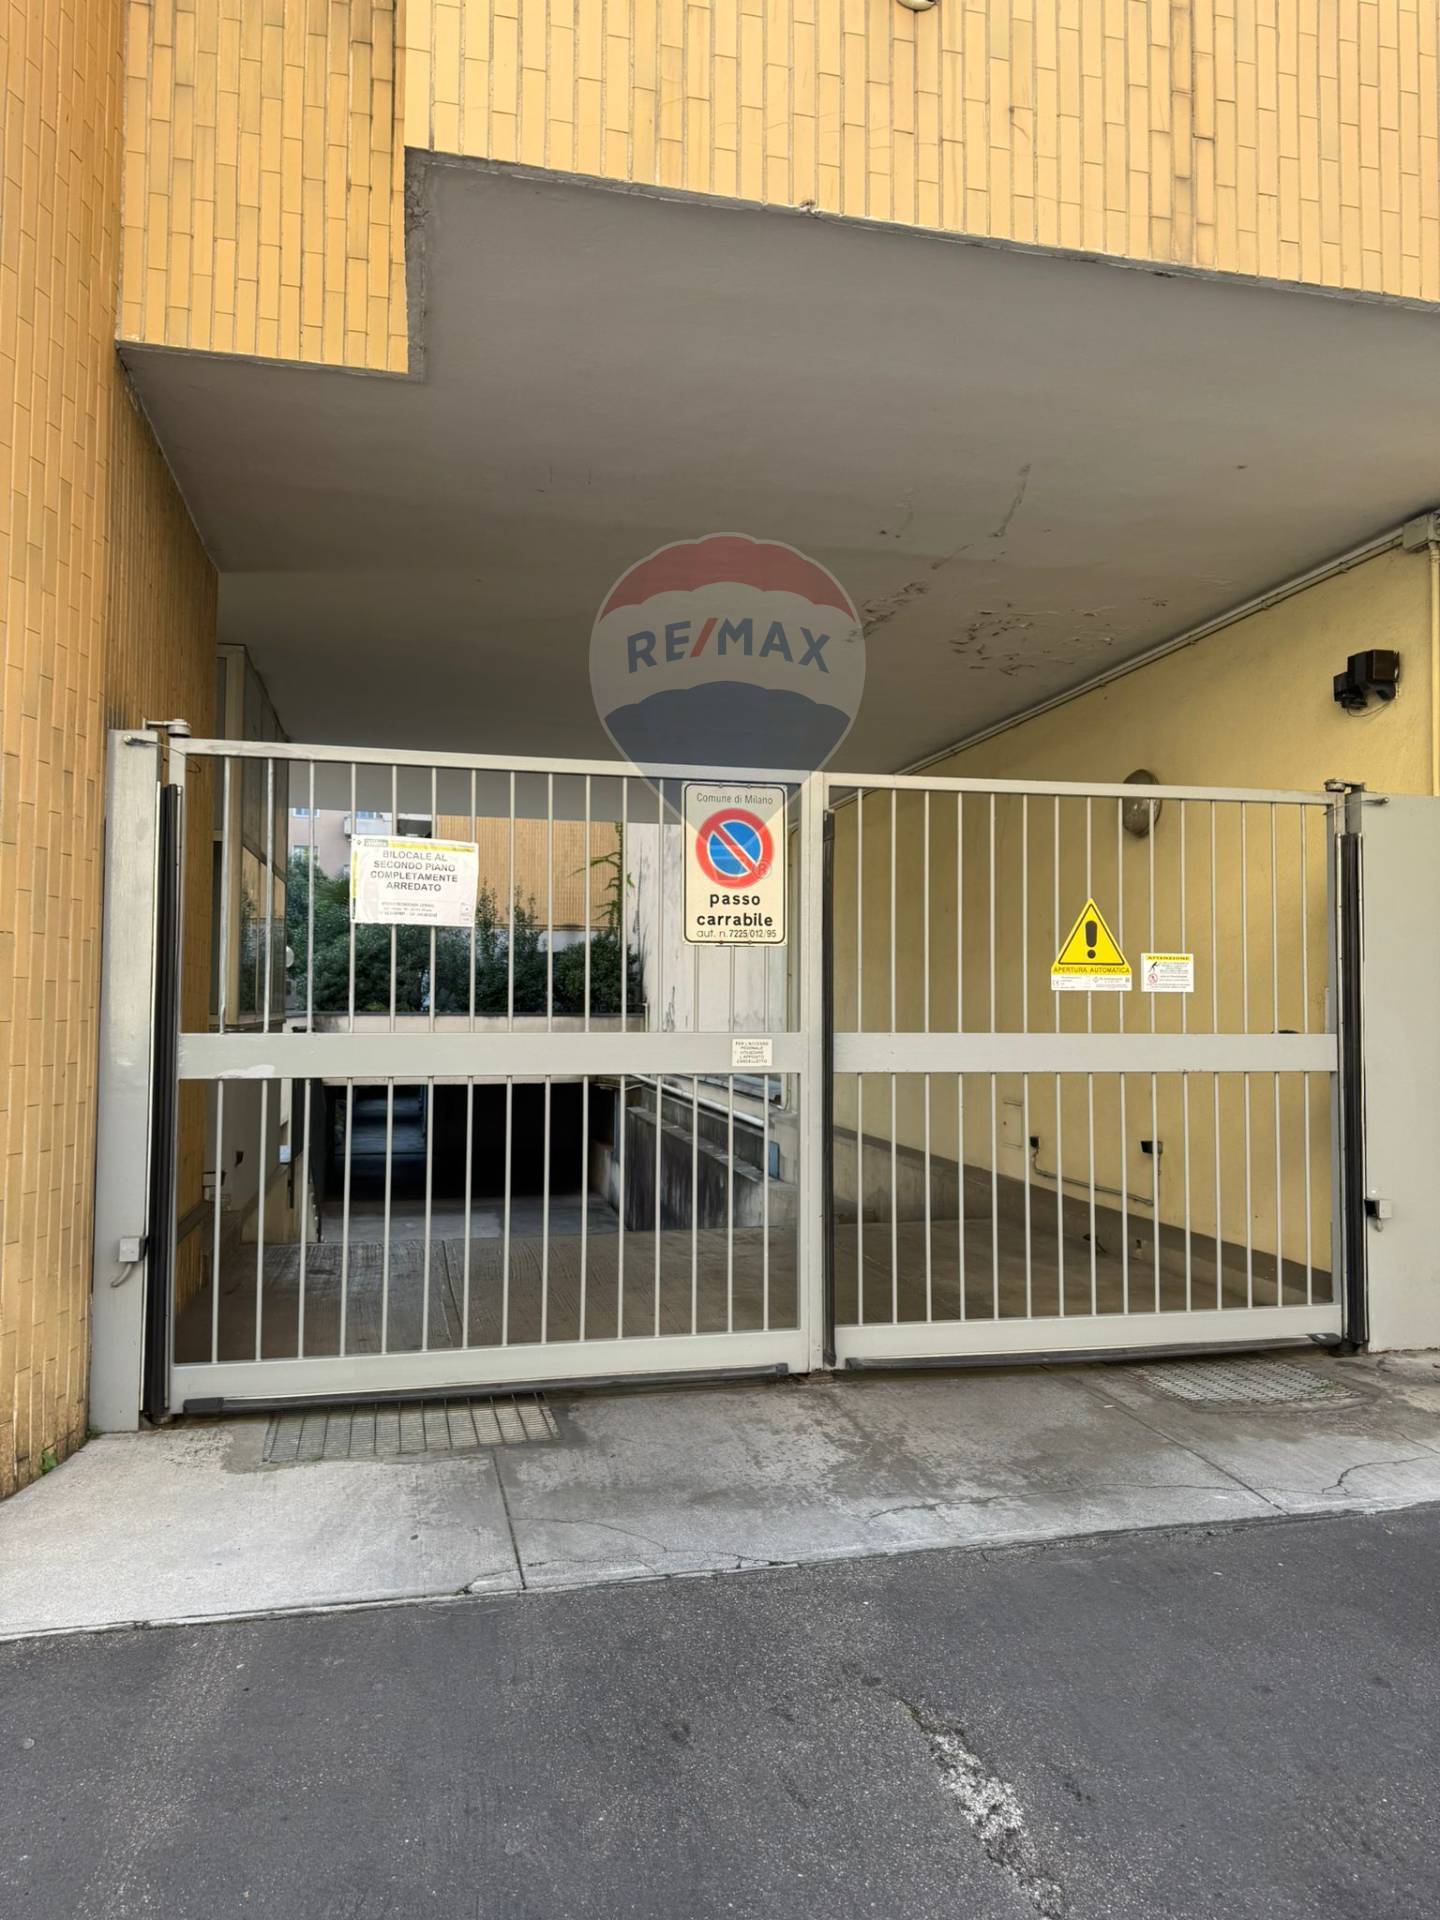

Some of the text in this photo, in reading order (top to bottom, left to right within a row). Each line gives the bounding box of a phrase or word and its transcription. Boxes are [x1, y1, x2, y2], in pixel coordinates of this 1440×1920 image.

[696, 793, 774, 805] Comune di Milano
[382, 850, 448, 862] BILOCALE AL
[374, 861, 456, 872] SECONDO PIANO
[370, 871, 458, 883] COMPLETAMENTE
[386, 882, 442, 892] ARREDATO
[710, 894, 761, 908] passo
[696, 913, 773, 927] carrabile
[696, 930, 716, 938] aut.
[1053, 966, 1088, 974] APERTURA
